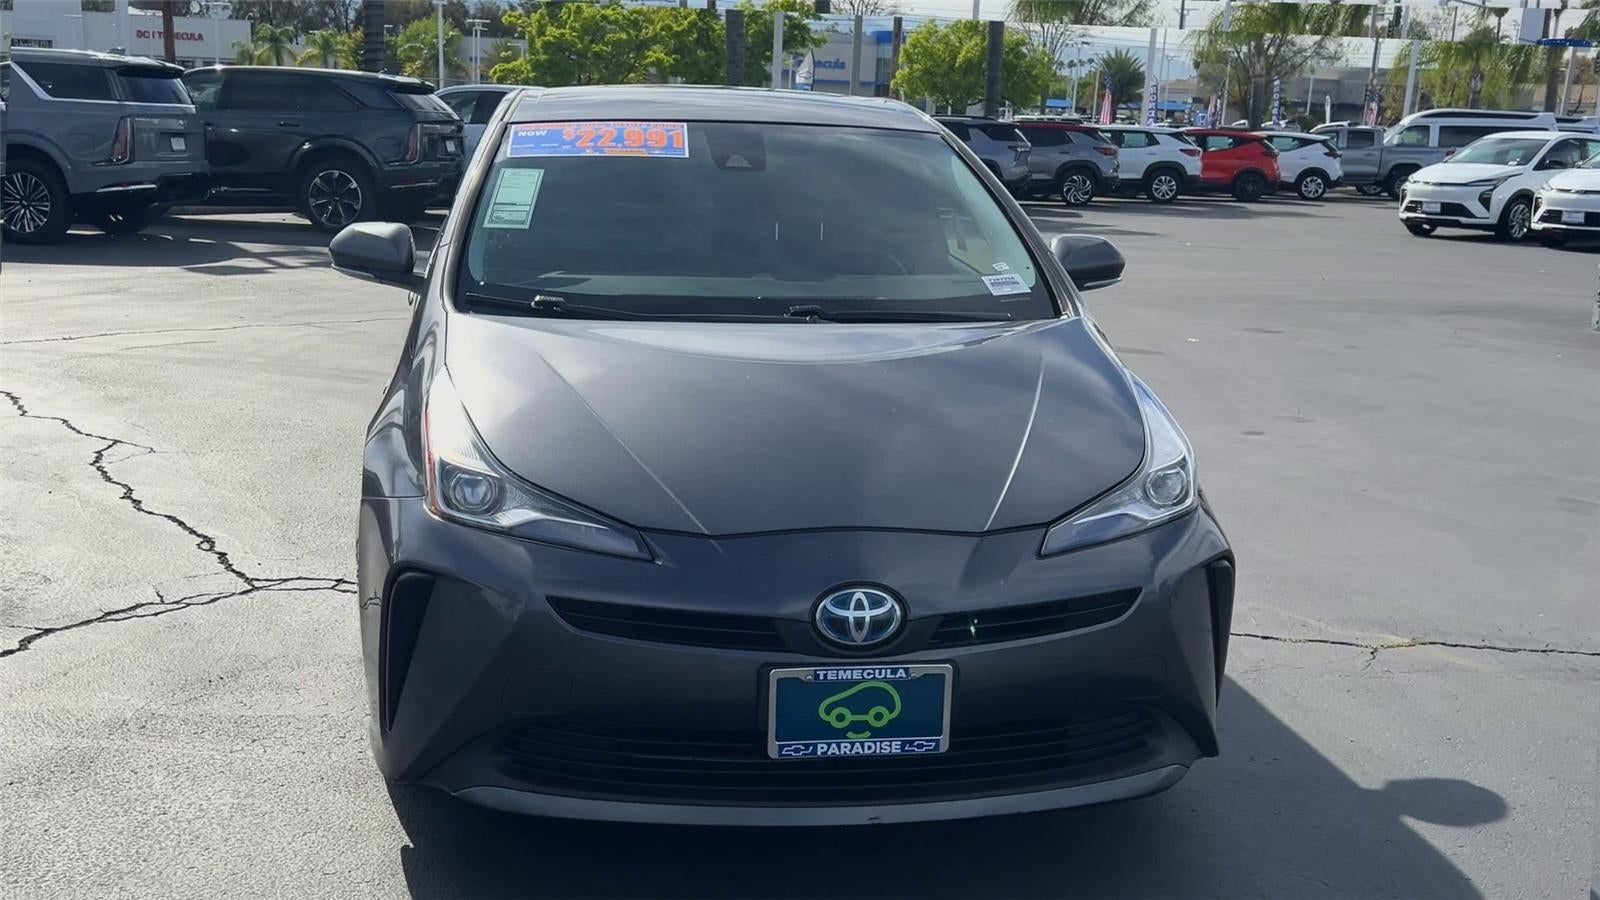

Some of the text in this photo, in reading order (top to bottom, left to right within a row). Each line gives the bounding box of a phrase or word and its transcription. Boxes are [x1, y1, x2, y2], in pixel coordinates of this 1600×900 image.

[157, 31, 204, 41] TECULA
[816, 668, 907, 680] TEMECULA
[816, 741, 902, 755] PARADISE
